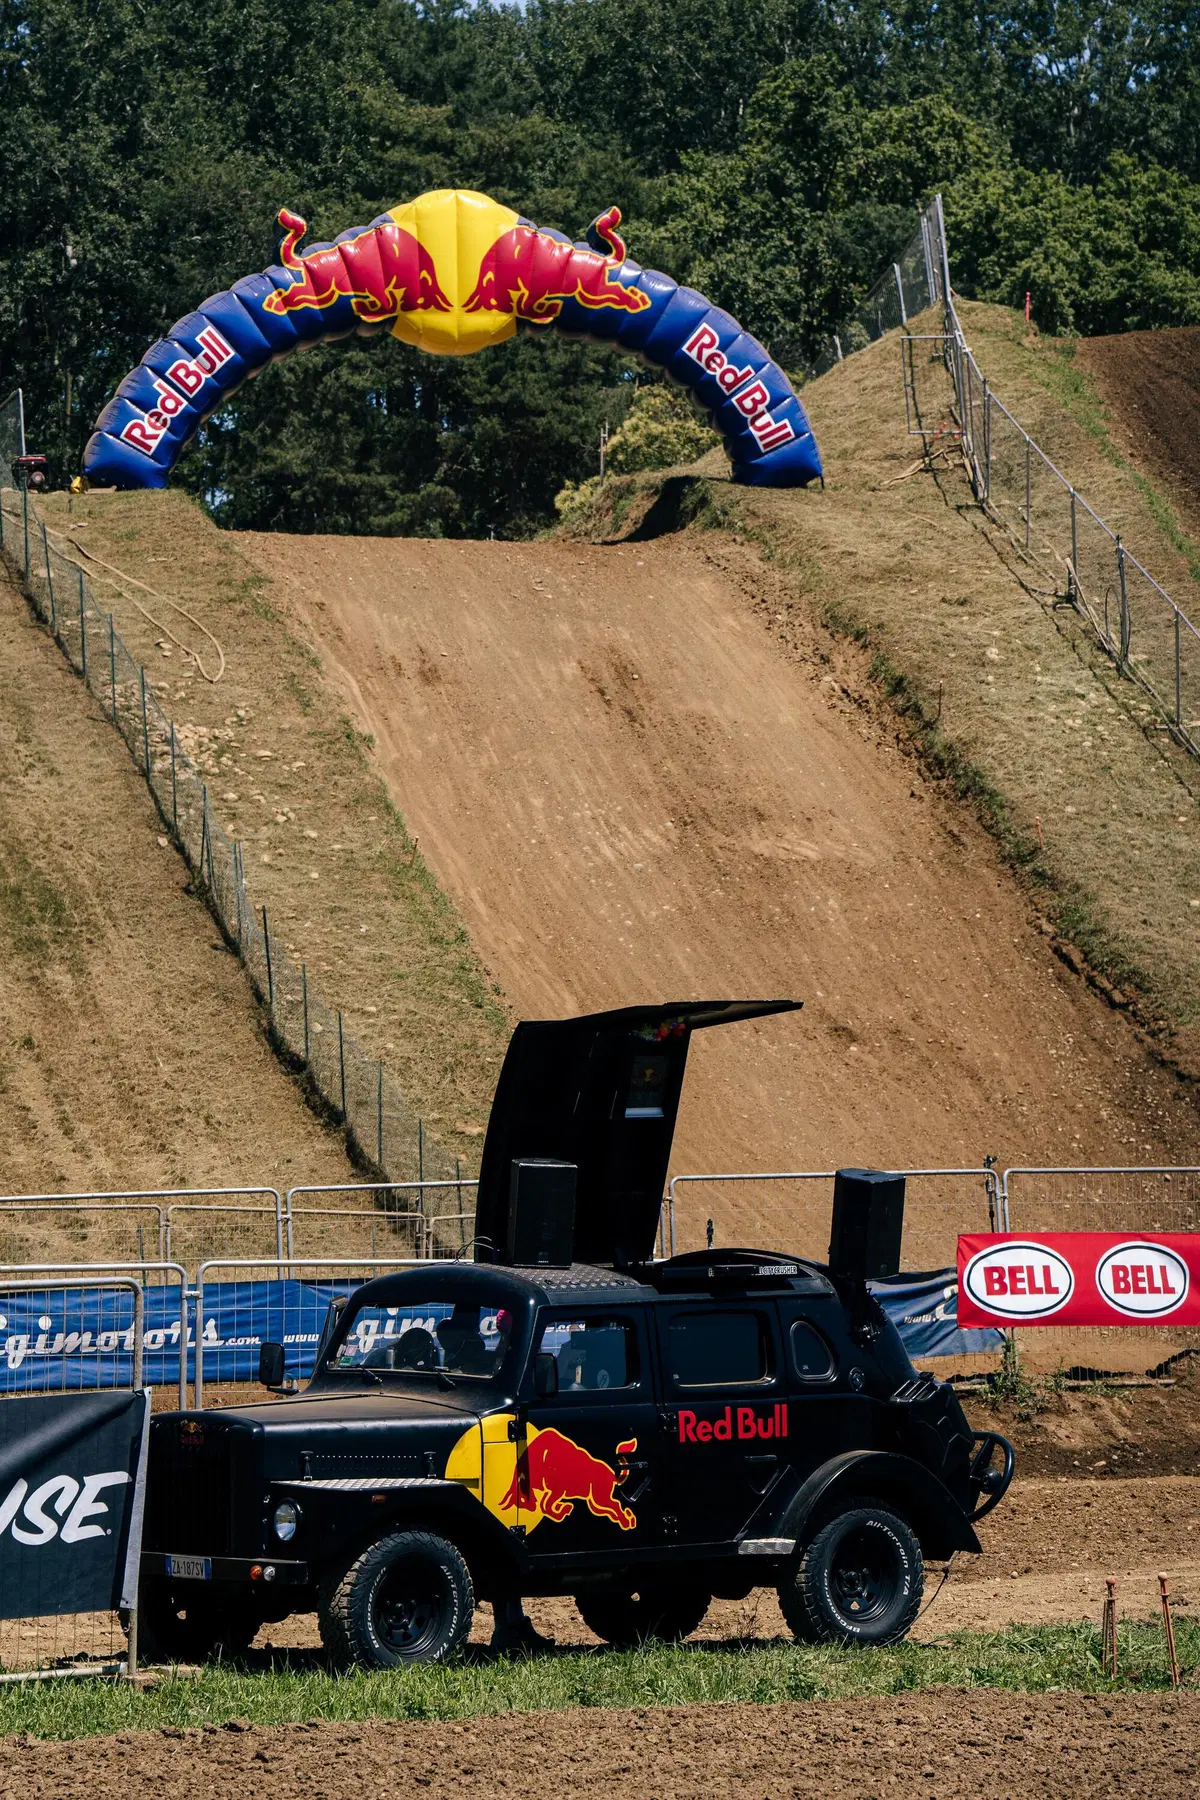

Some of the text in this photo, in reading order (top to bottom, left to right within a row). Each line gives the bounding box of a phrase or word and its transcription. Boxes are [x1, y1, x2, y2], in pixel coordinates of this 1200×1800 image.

[120, 325, 236, 456] Red Bull
[682, 322, 796, 453] Red Bull
[983, 1264, 1060, 1296] BELL
[1111, 1264, 1176, 1295] BELL
[678, 1404, 788, 1442] Red Bull
[866, 1520, 911, 1596] All-Terrain T/A
[440, 1565, 459, 1637] All-Terrain
